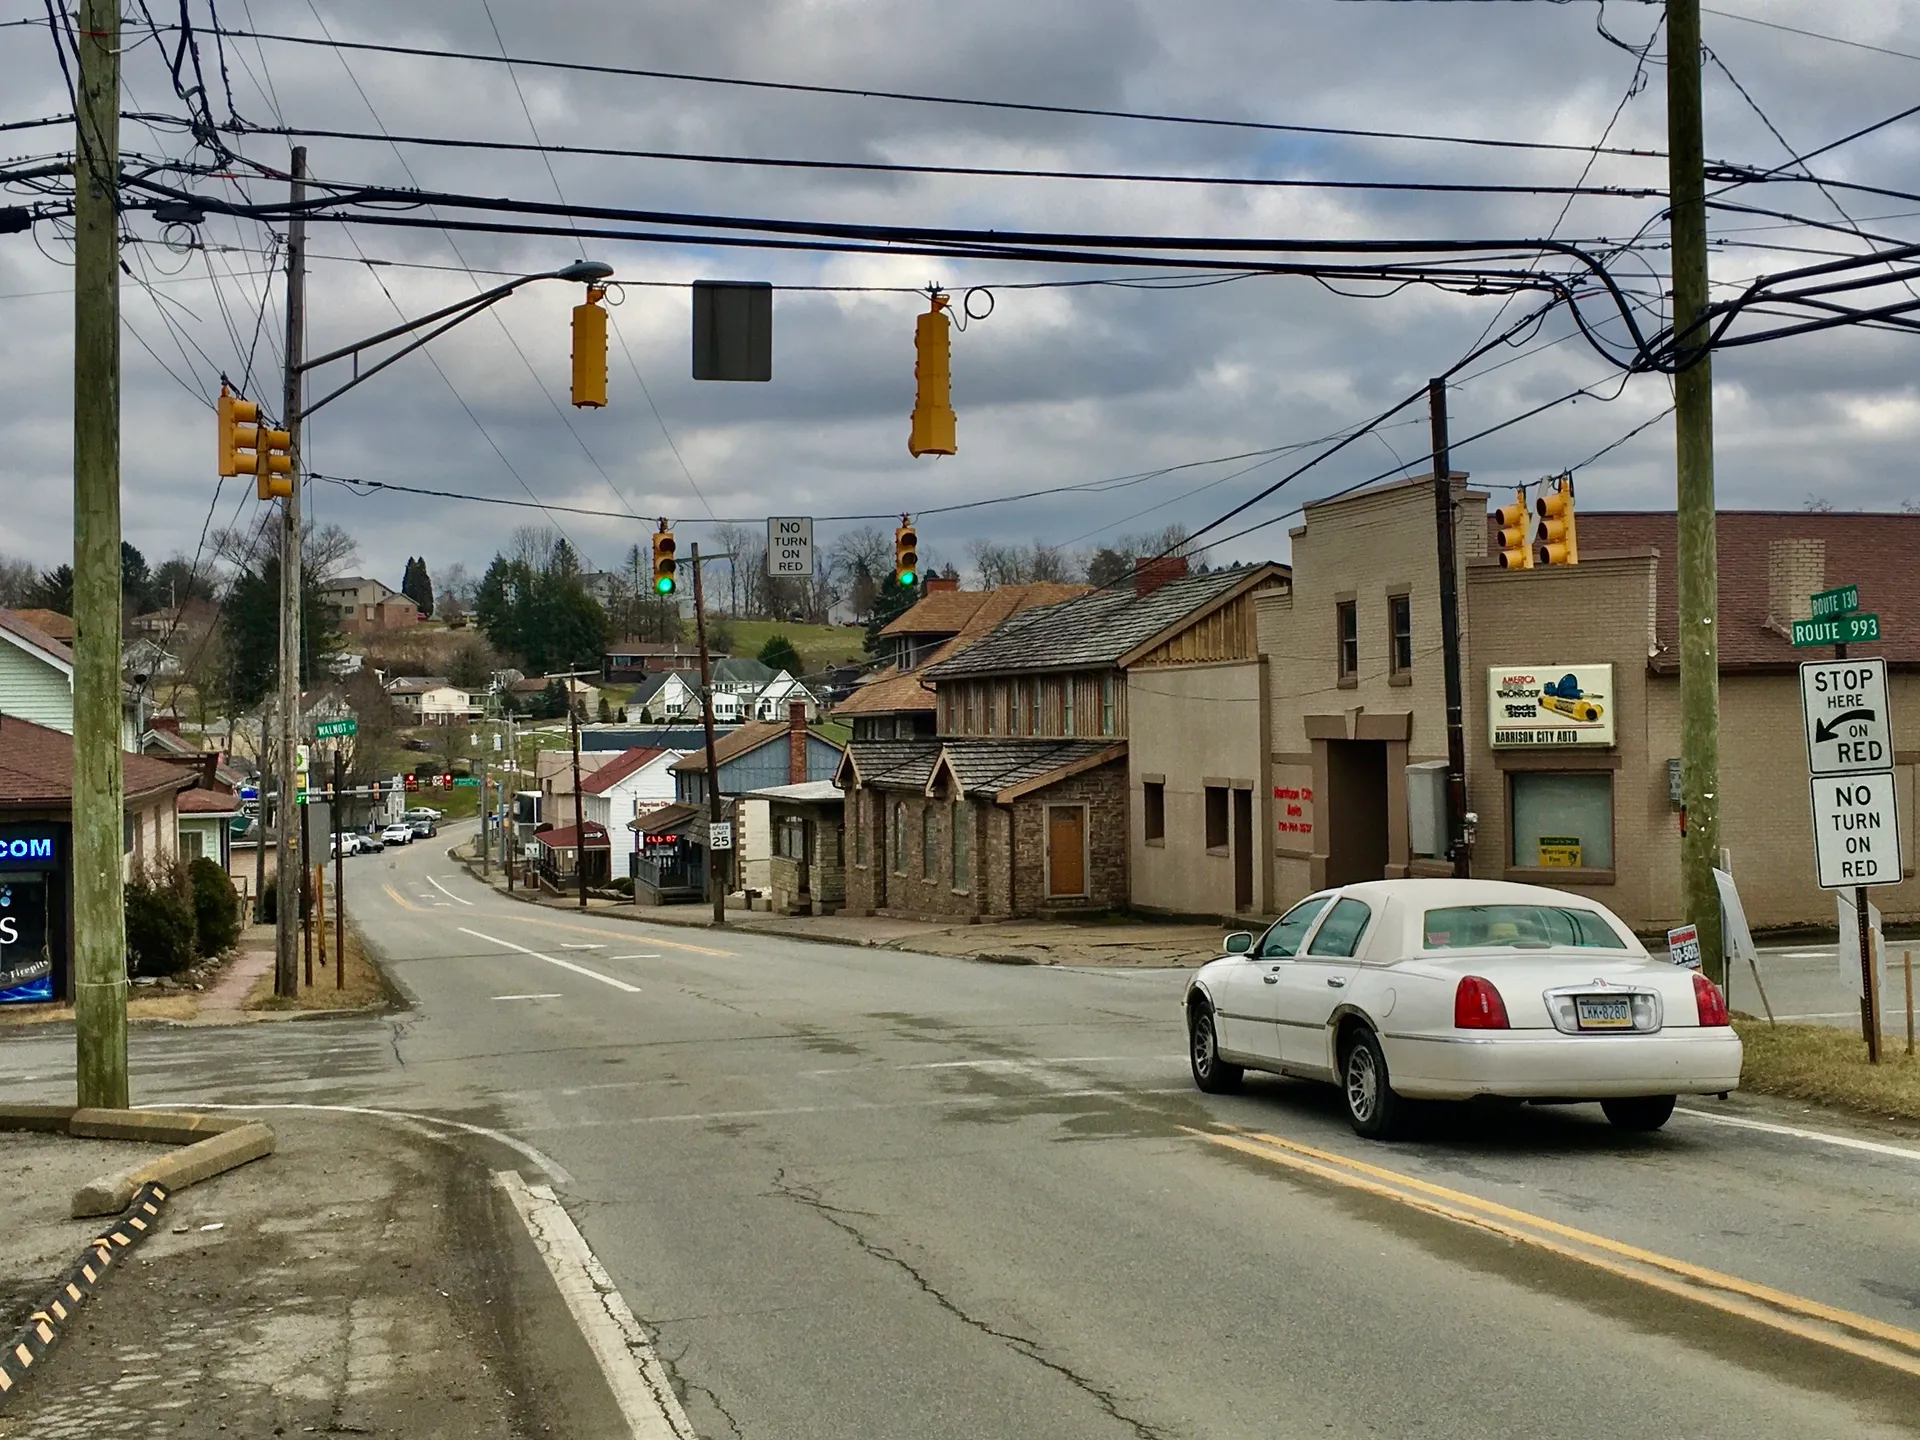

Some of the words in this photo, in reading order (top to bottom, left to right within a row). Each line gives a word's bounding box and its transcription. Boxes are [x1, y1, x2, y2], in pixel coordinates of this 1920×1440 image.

[780, 522, 800, 533] NO
[774, 537, 807, 546] TURN
[782, 550, 800, 558] ON
[779, 562, 803, 571] RED
[1812, 595, 1839, 616] ROUTE
[1842, 590, 1858, 608] 130
[1795, 622, 1840, 642] ROUTE
[1851, 619, 1878, 637] 993
[1502, 675, 1536, 684] AMERICA
[1814, 669, 1873, 692] STOP
[1500, 689, 1538, 698] MONROE
[1827, 694, 1864, 708] HERE
[318, 723, 347, 736] WALNUT
[1849, 724, 1868, 737] ON
[1495, 731, 1533, 743] HARRISON
[1537, 731, 1554, 743] CITY
[1557, 731, 1577, 742] AUTO
[1837, 741, 1883, 763] RED
[1835, 785, 1871, 807] NO
[1832, 812, 1881, 830] TURN
[712, 836, 729, 847] 25
[1846, 836, 1871, 853] ON
[1842, 860, 1878, 878] RED
[10, 959, 49, 979] Firepits
